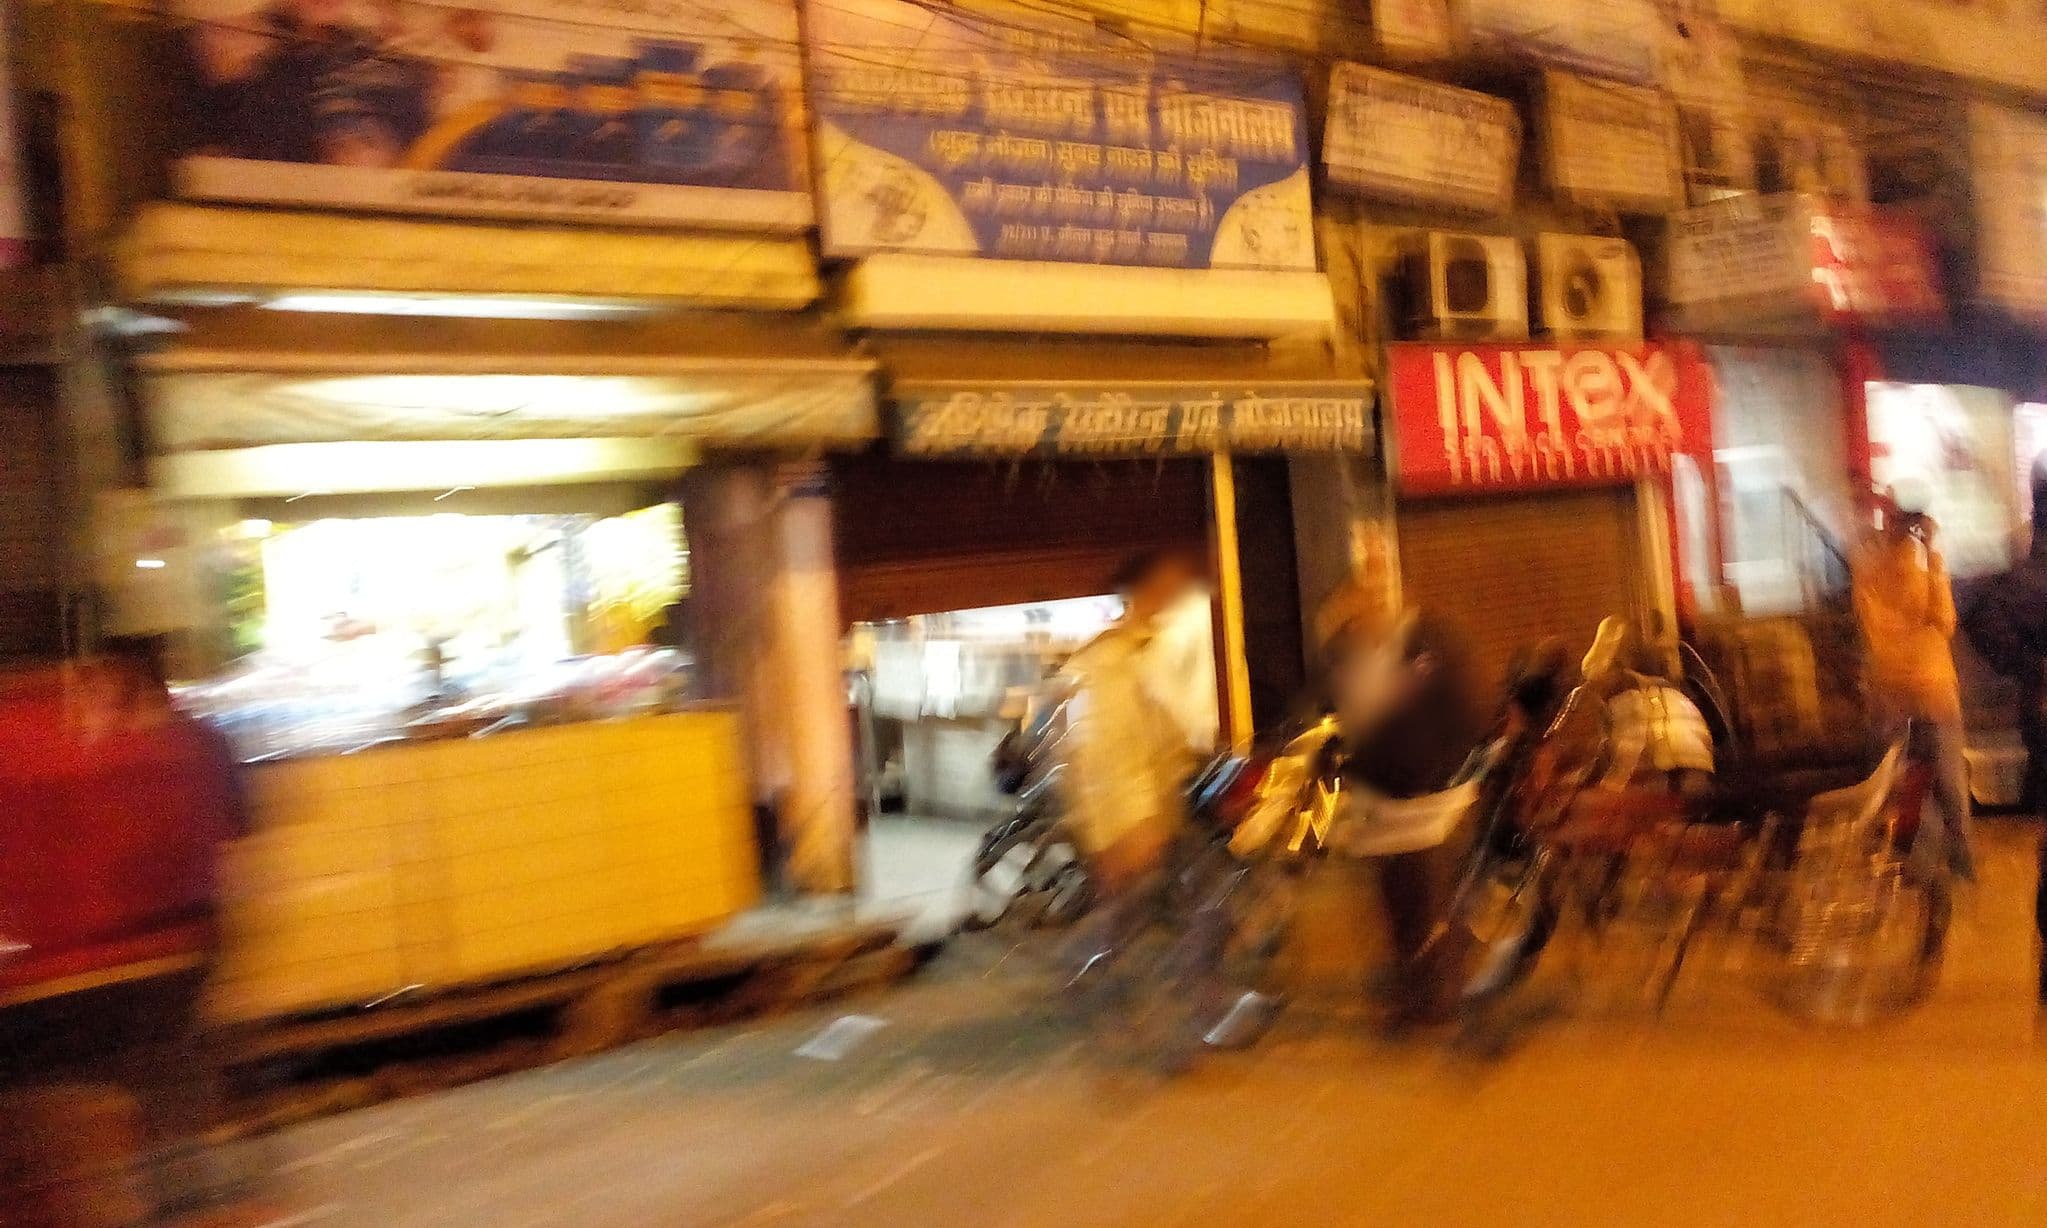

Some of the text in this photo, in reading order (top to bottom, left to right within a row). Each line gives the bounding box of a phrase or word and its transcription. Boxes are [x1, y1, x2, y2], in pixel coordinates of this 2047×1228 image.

[1158, 80, 1297, 154] भोजनालय
[1058, 139, 1101, 173] सुबह
[1232, 390, 1364, 441] भोजनालय
